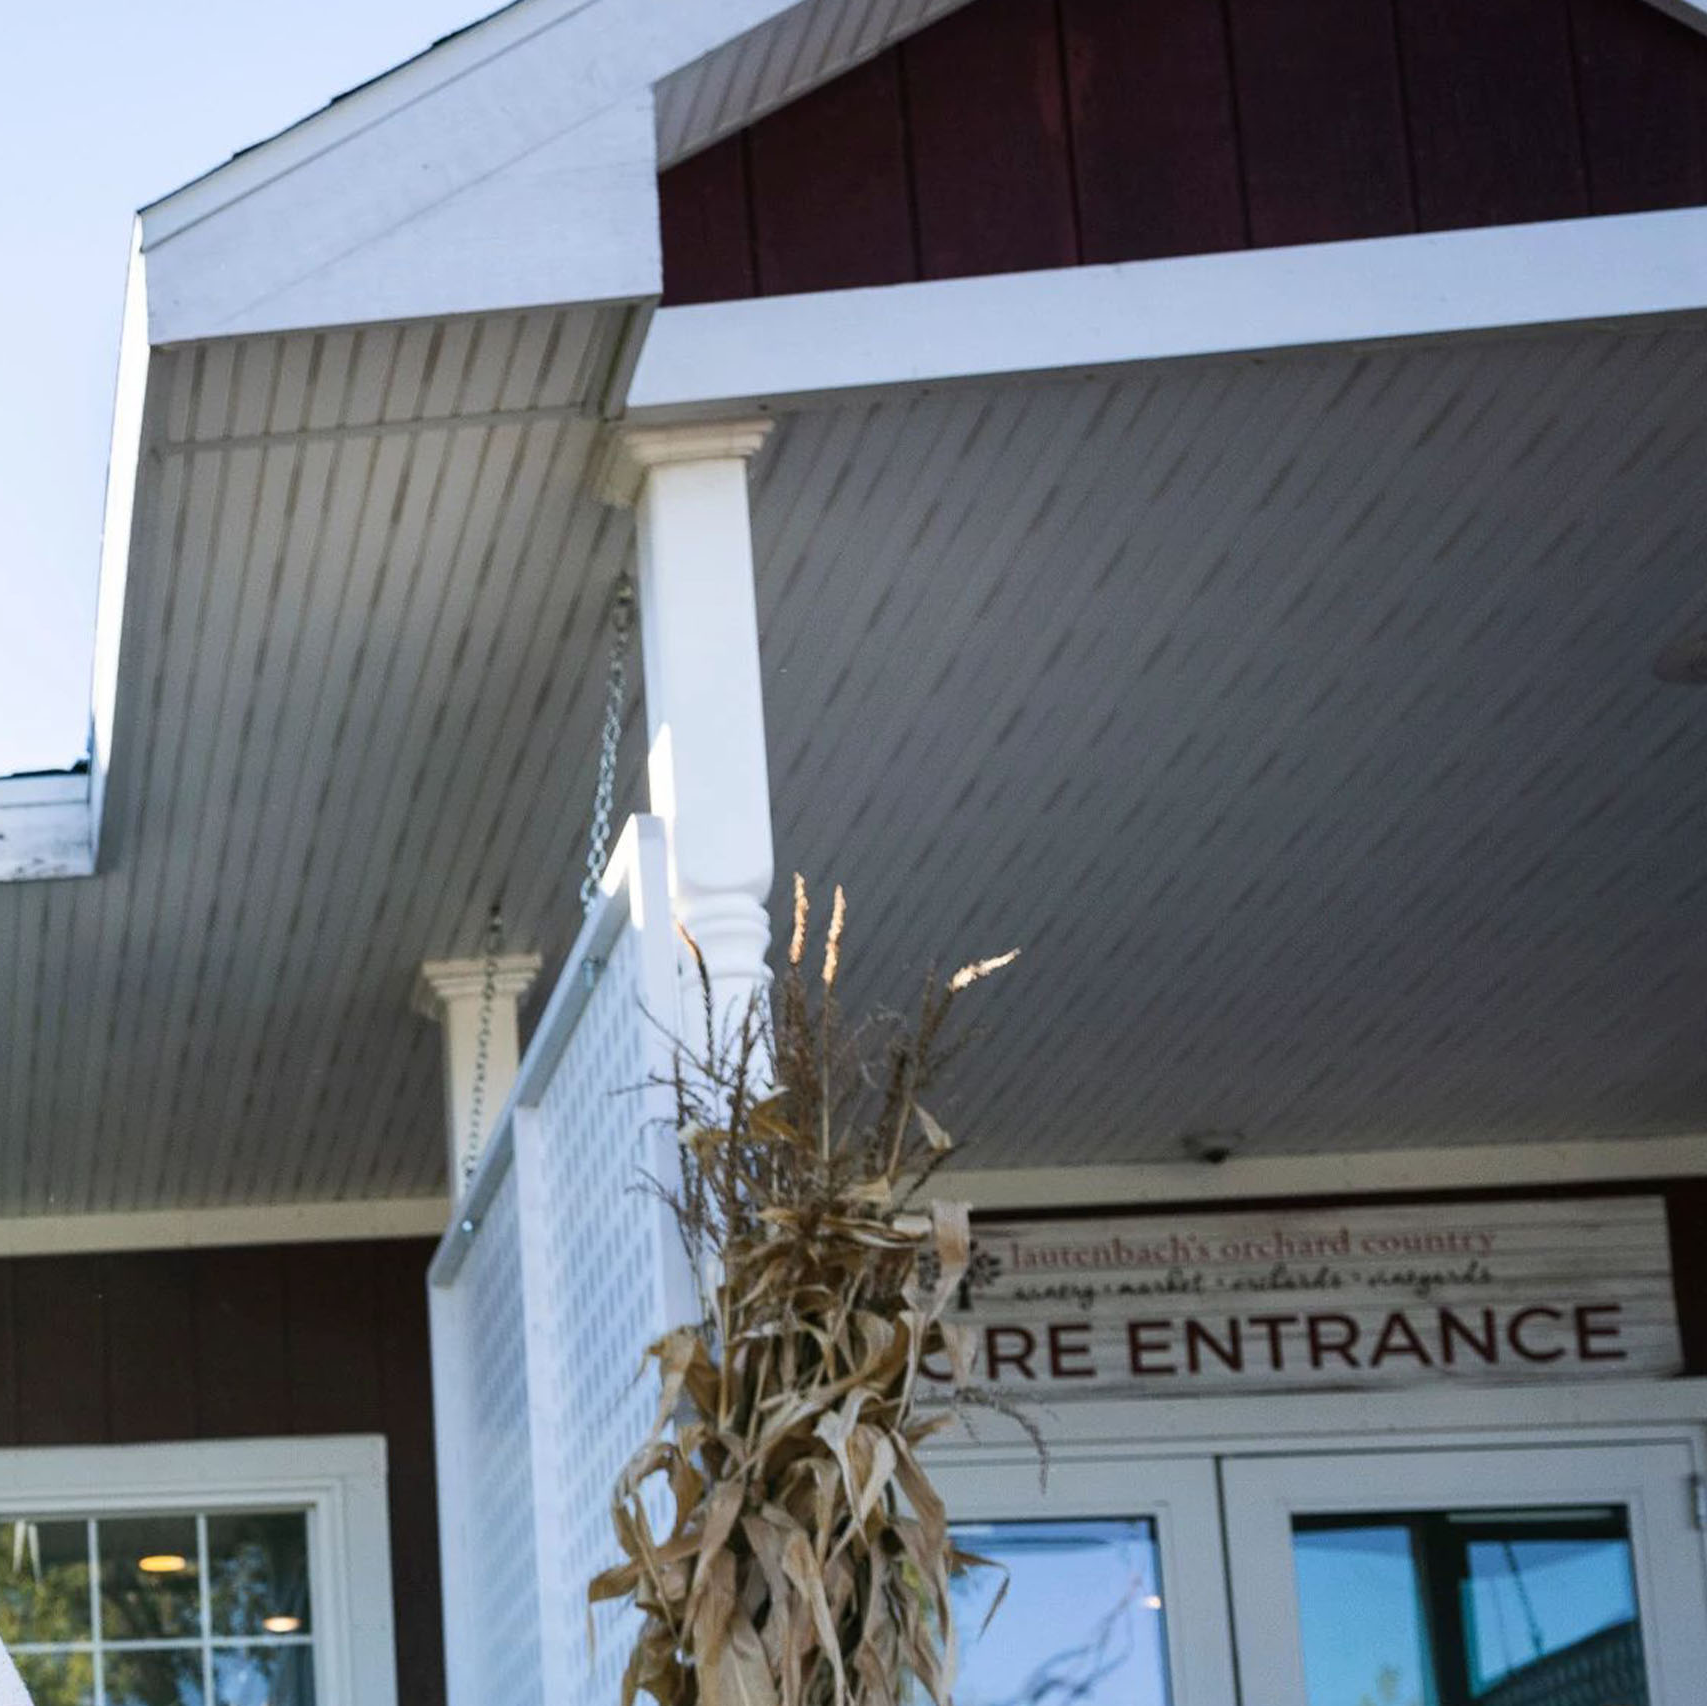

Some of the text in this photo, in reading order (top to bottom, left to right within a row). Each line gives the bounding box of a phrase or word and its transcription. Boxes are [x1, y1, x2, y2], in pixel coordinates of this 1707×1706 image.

[1010, 1227, 1496, 1269] lautenbach's orchard country
[1128, 1303, 1629, 1378] ENTRANCE
